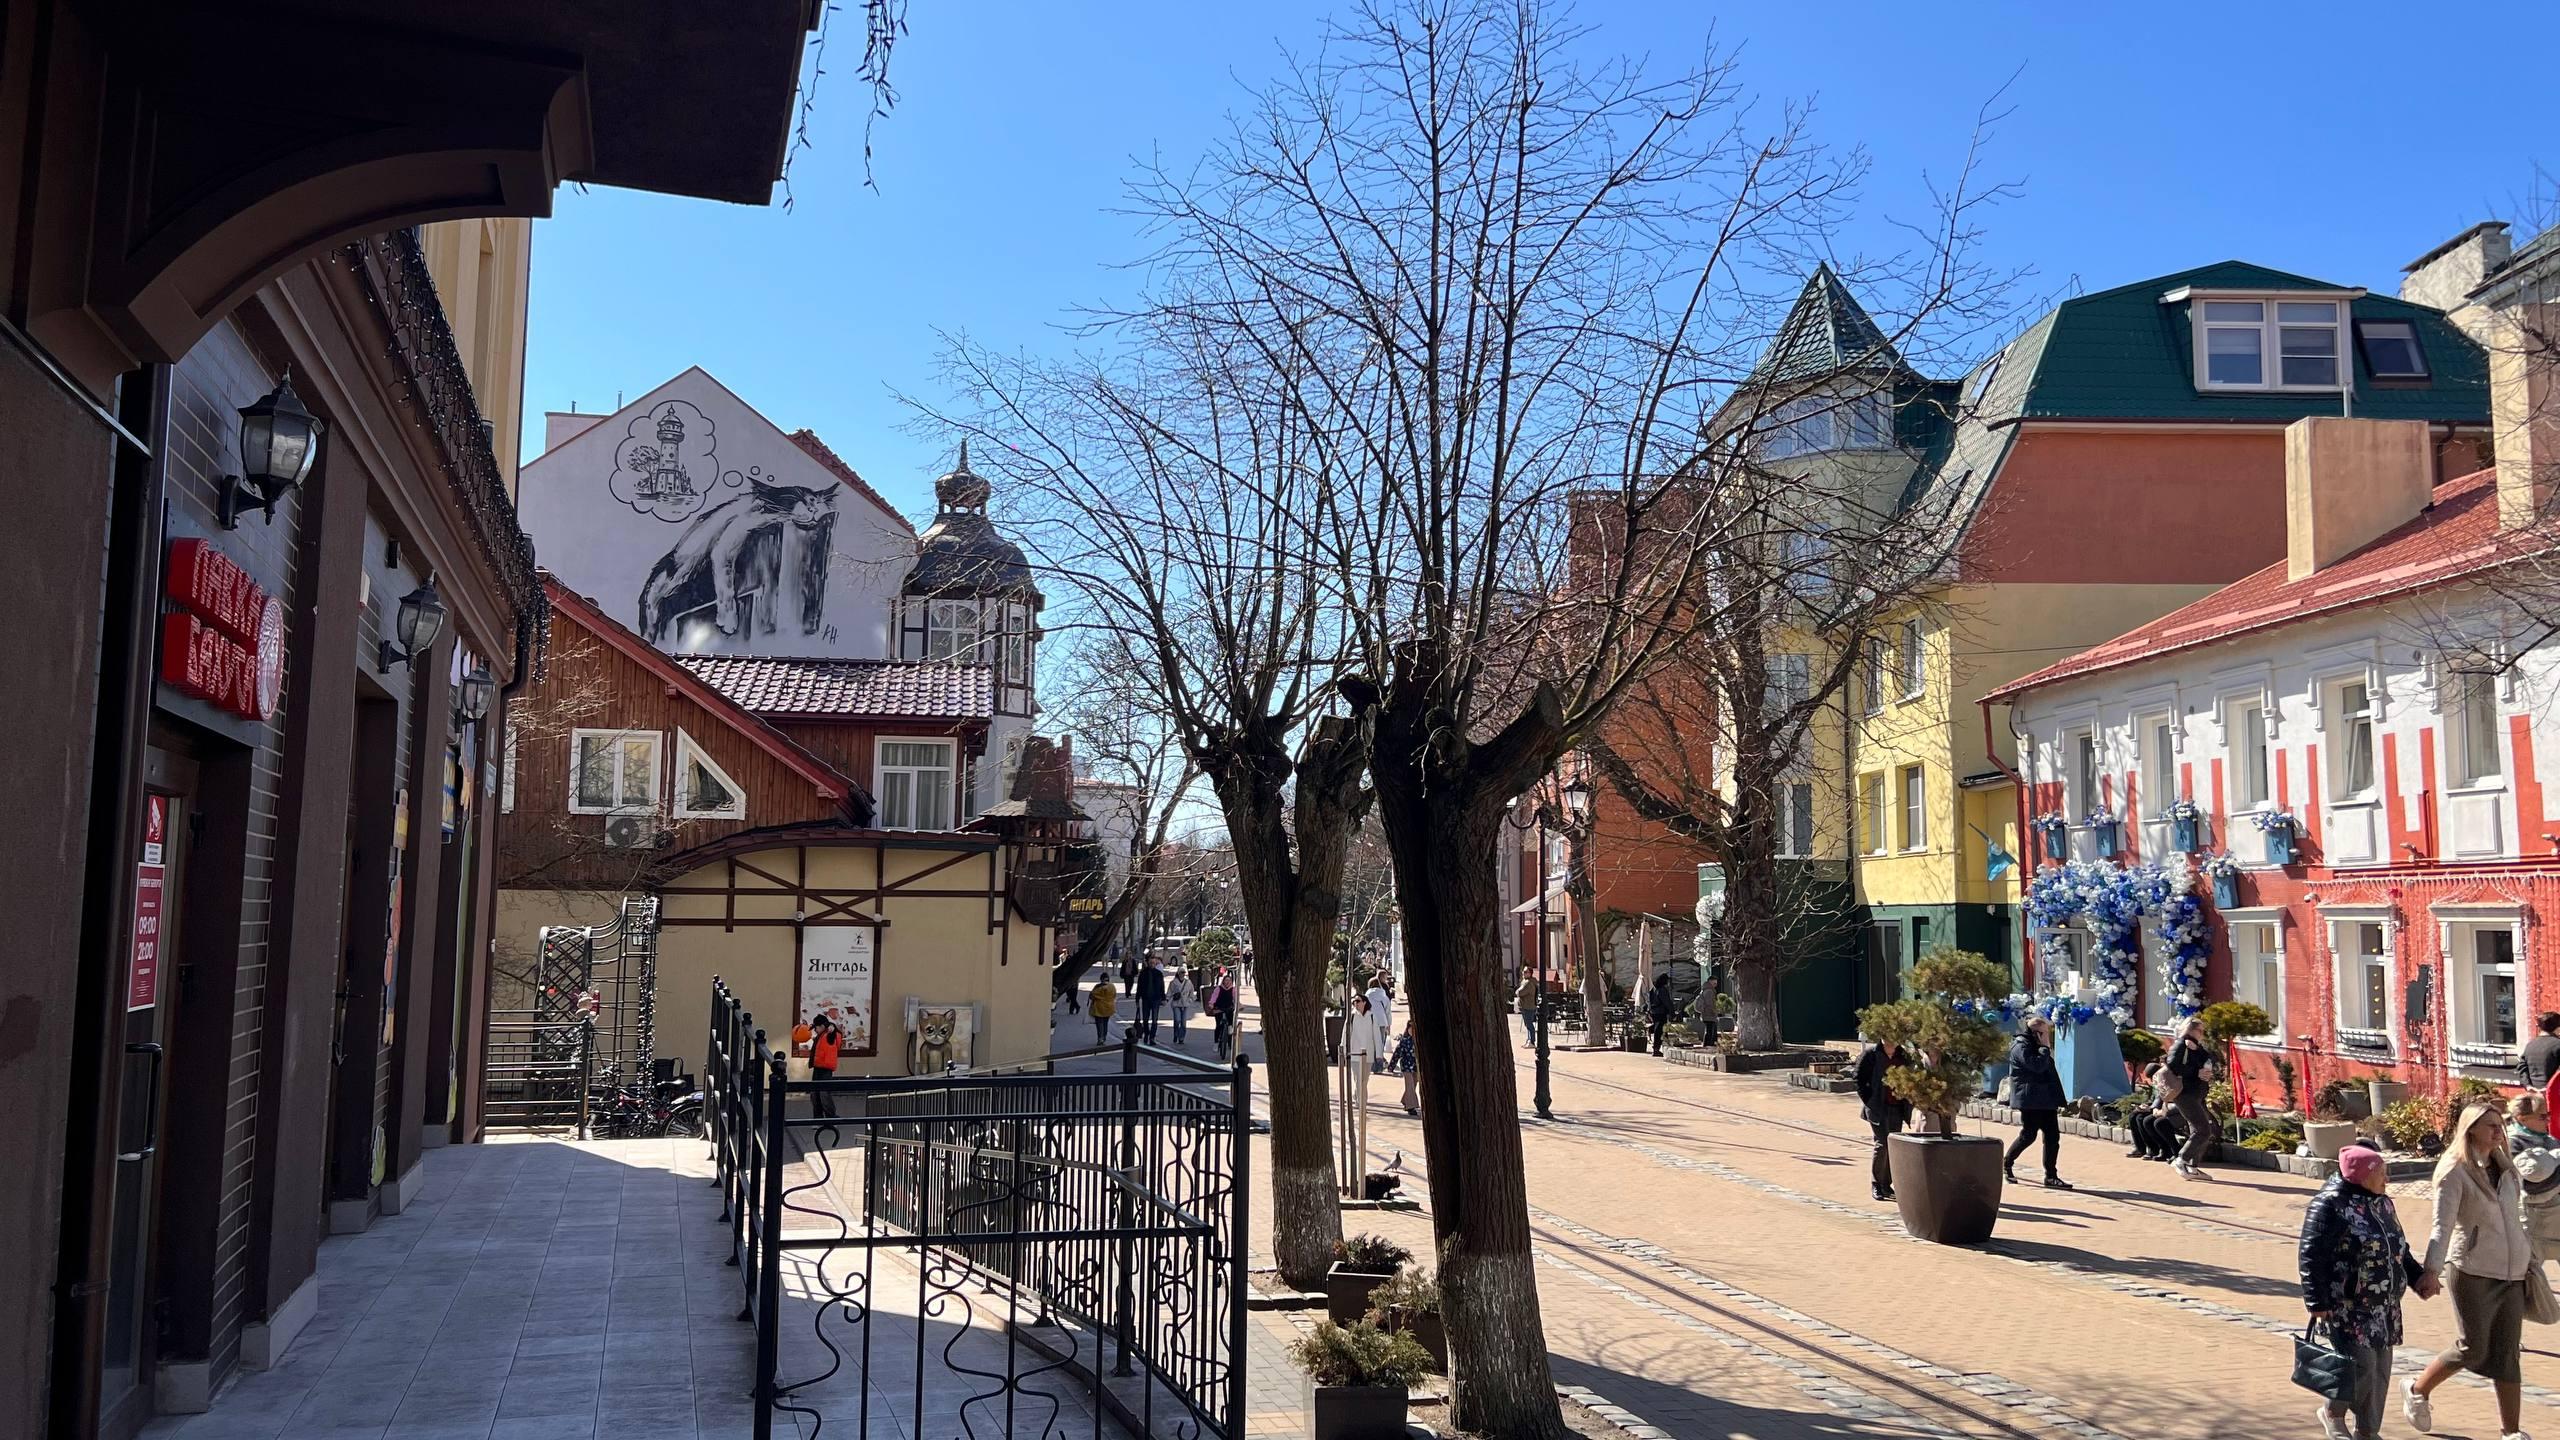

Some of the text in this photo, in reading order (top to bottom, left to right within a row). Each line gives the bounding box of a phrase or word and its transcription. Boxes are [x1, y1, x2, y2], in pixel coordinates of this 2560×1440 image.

[1069, 897, 1103, 912] ЯНТАРЬ
[138, 916, 157, 935] 09:00
[137, 941, 154, 961] 21:00
[808, 958, 868, 976] Янтарь
